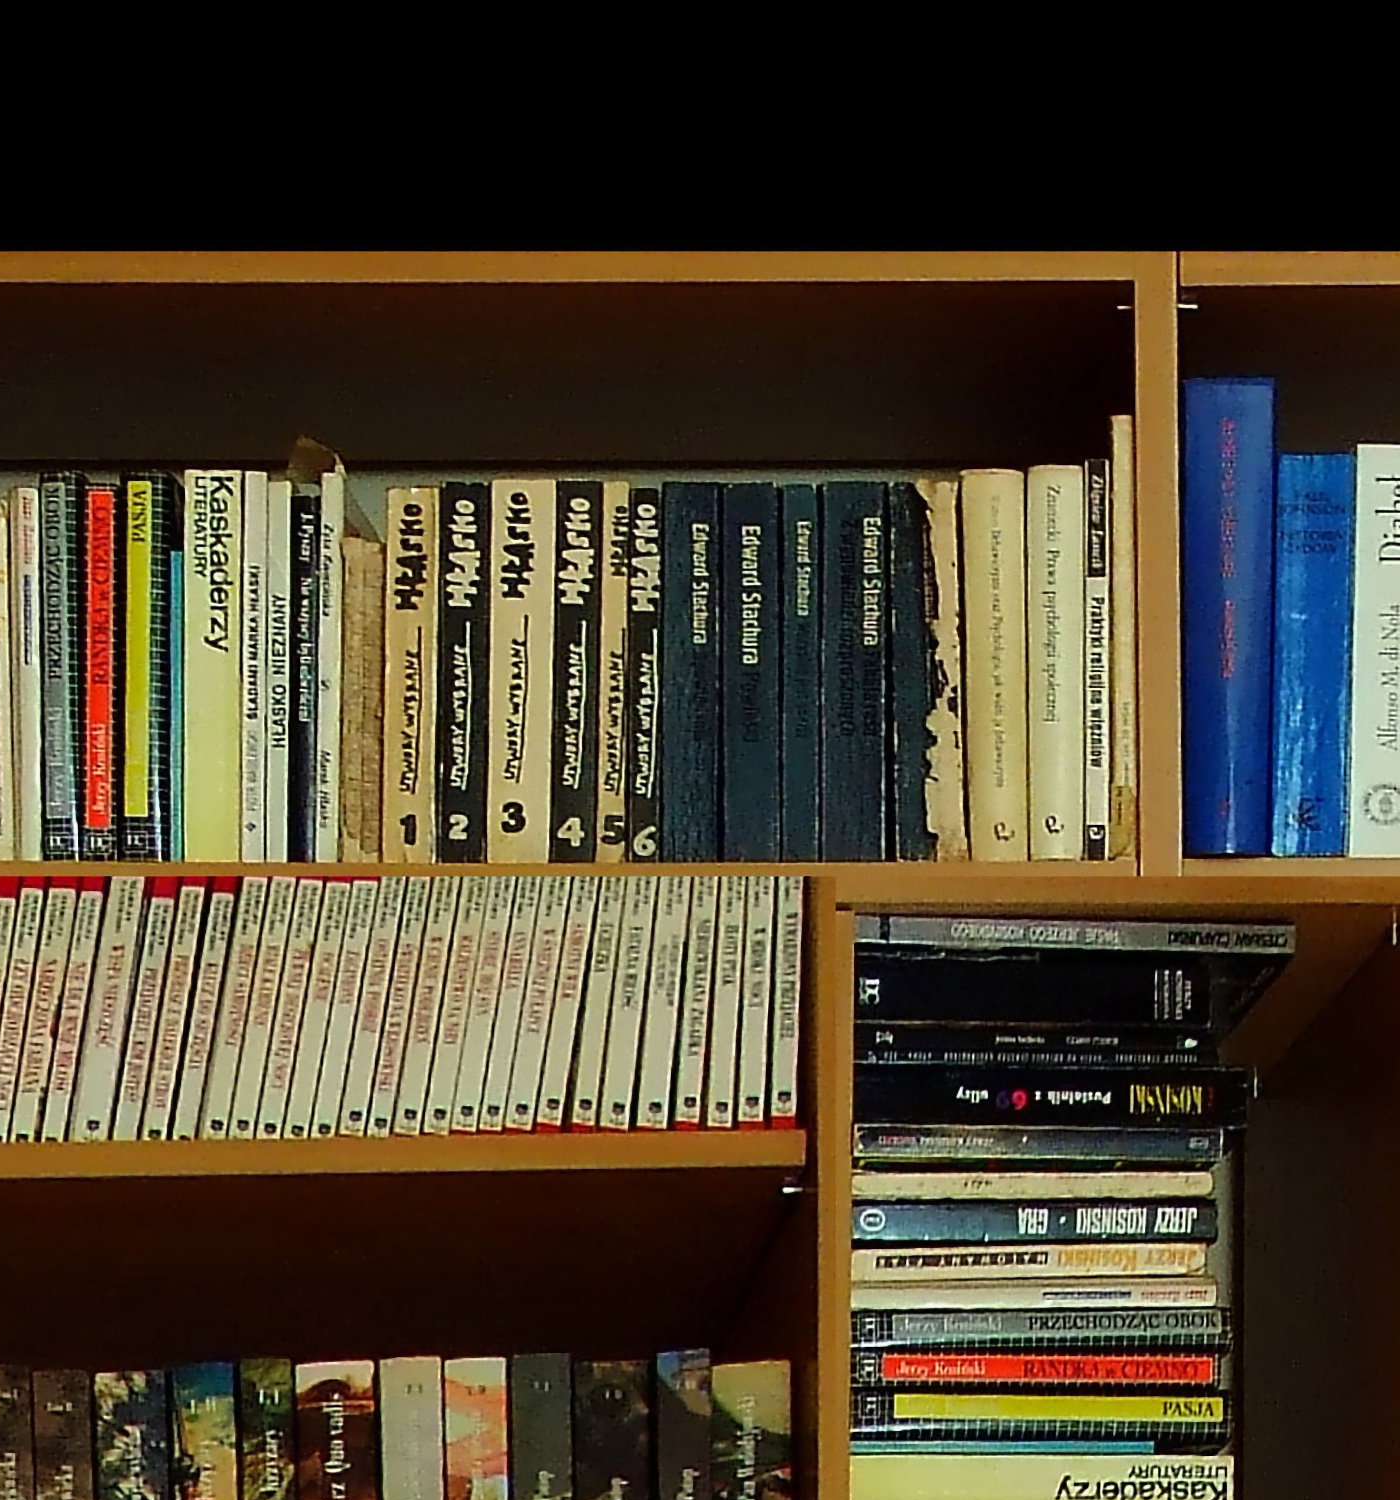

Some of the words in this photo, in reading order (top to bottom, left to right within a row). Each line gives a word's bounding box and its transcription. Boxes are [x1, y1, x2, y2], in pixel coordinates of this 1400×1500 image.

[192, 477, 208, 577] LITERATURY
[742, 525, 762, 591] Edward
[202, 476, 234, 652] Kaskaderzy
[742, 593, 762, 666] Stachura
[501, 803, 527, 833] 3
[1128, 1465, 1227, 1479] LITERATURY
